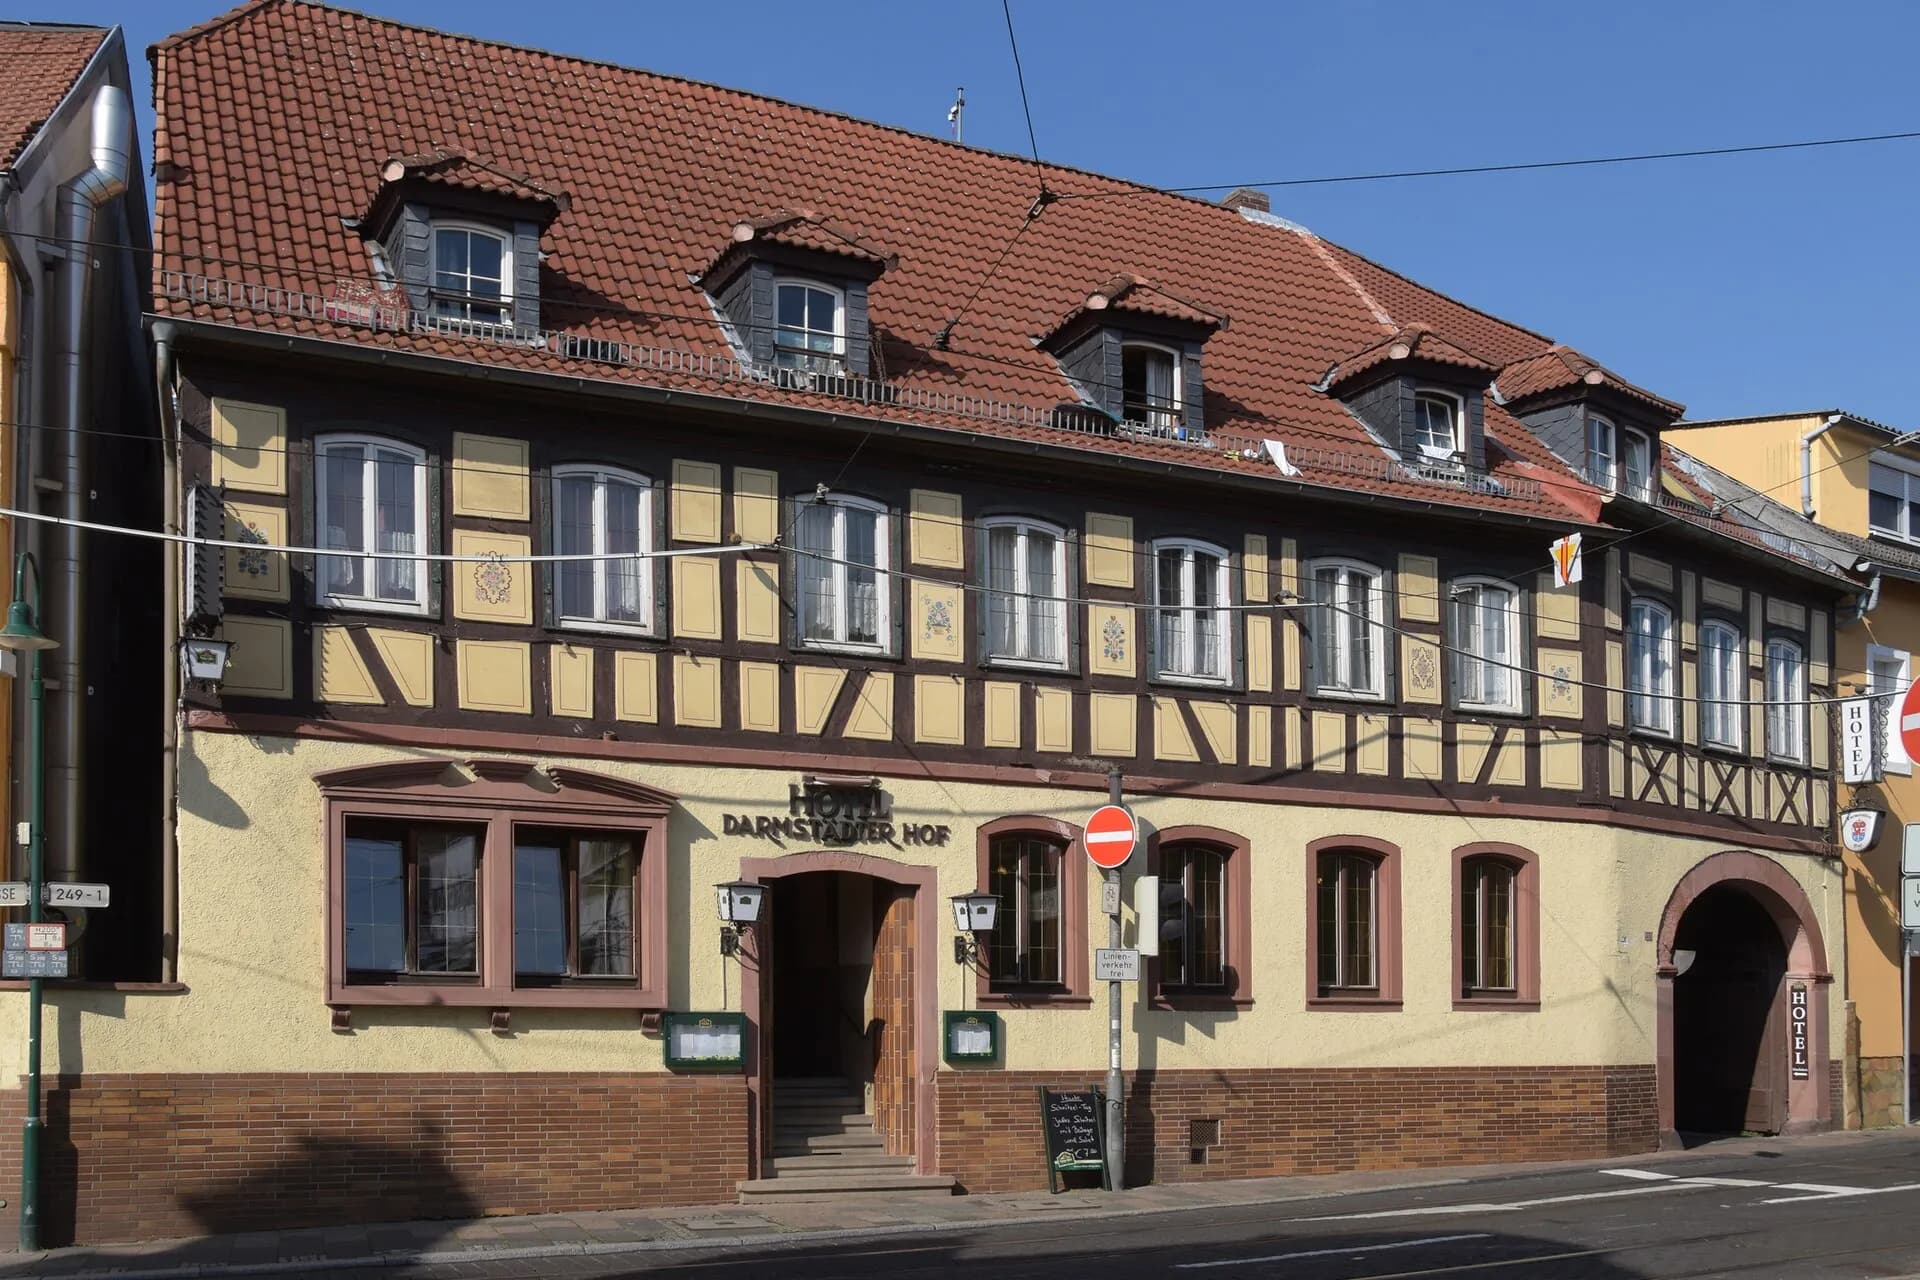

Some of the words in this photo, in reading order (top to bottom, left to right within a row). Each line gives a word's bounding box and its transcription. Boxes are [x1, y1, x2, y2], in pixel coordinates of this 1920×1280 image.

[1850, 707, 1863, 776] HOTEL
[722, 813, 904, 851] DARMSTÄDTER
[902, 822, 951, 847] HOF
[0, 887, 16, 900] SE
[1101, 961, 1133, 969] verkehr
[1103, 952, 1131, 960] Linien-
[1792, 992, 1806, 1065] HOTEL
